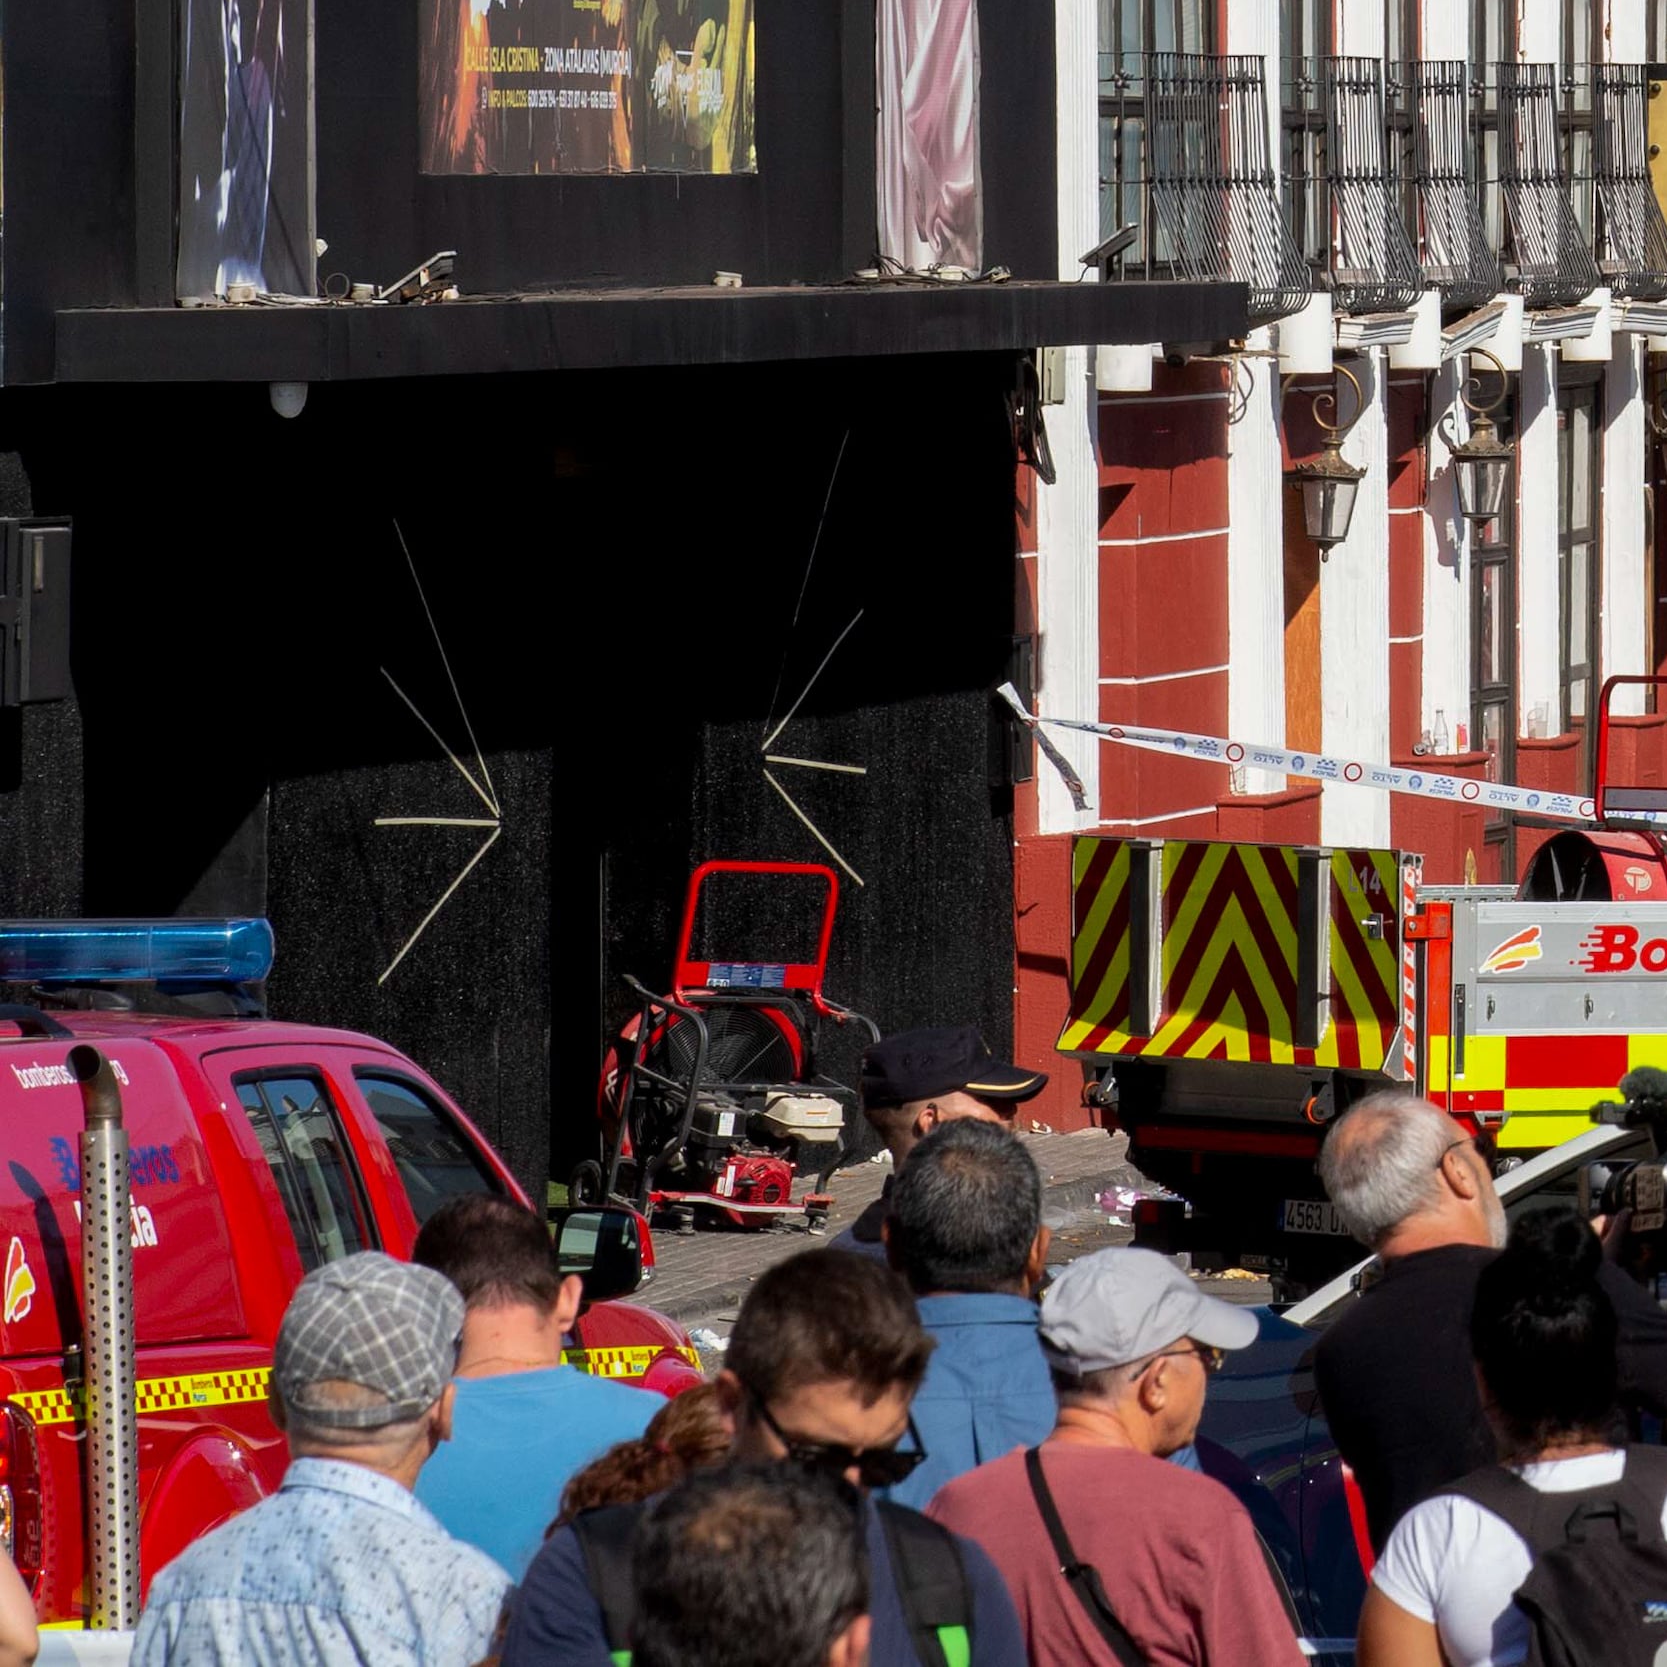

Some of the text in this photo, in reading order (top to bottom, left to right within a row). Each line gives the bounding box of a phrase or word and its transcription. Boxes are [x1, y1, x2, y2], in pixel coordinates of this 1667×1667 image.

[466, 46, 489, 72] CALLE
[489, 46, 506, 73] ISLA
[506, 47, 540, 73] CRISTINA
[544, 47, 564, 73] ZONA
[564, 48, 599, 74] ATALAYAS
[600, 46, 632, 78] (MURCIA)
[1489, 792, 1520, 803] ALTO
[1349, 865, 1381, 895] L14
[1286, 1201, 1322, 1231] 4563
